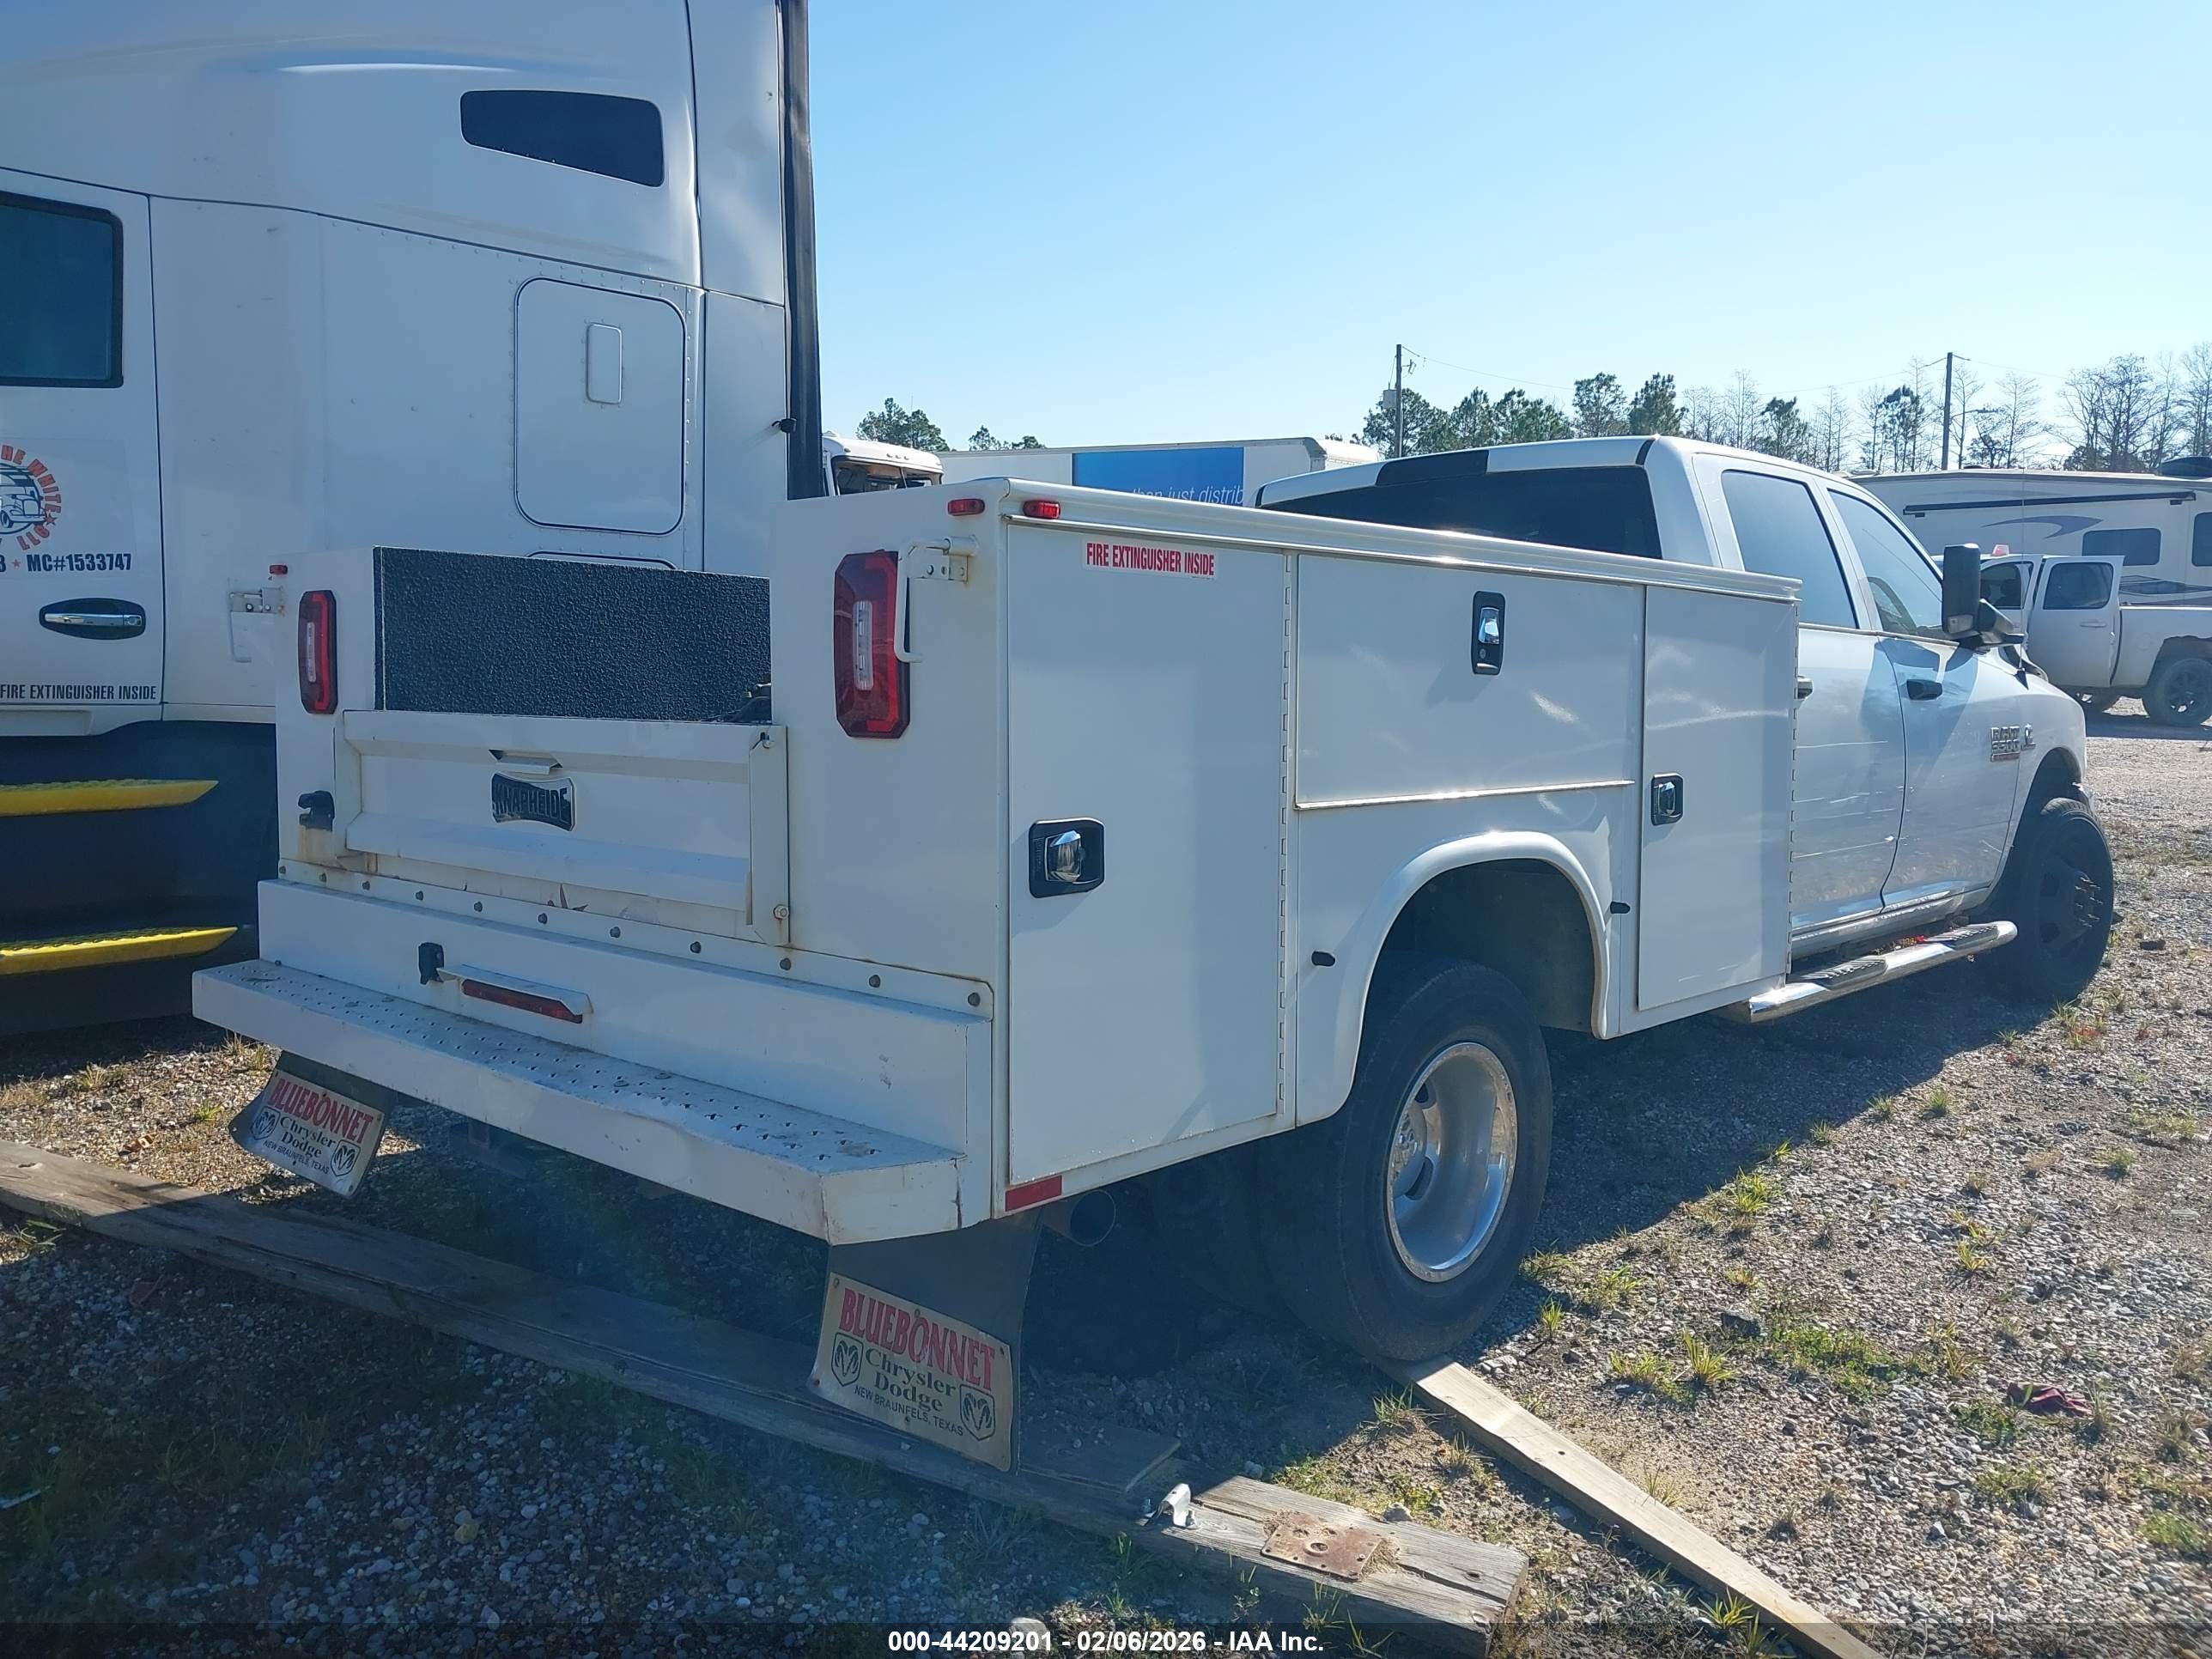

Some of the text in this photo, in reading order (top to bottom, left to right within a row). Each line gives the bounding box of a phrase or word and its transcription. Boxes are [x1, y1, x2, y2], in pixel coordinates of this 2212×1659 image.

[27, 459, 62, 514] WHITE
[27, 553, 131, 572] MC#1533747
[1086, 543, 1215, 575] FIRE EXTINGUISHER INSIDE
[0, 684, 156, 700] FIRE EXTINGUISHER INSIDE
[268, 1079, 374, 1144] BLUEBONNET
[280, 1115, 336, 1148] Chrysler
[281, 1131, 322, 1158] Dodge
[263, 1139, 276, 1151] NEW
[313, 1160, 330, 1175] TEXAS
[838, 1287, 995, 1391] BLUEBONNET
[865, 1347, 957, 1397] Chrysler
[873, 1371, 943, 1412] Dodge
[854, 1385, 874, 1403] NEW
[933, 1418, 964, 1437] TEXAS
